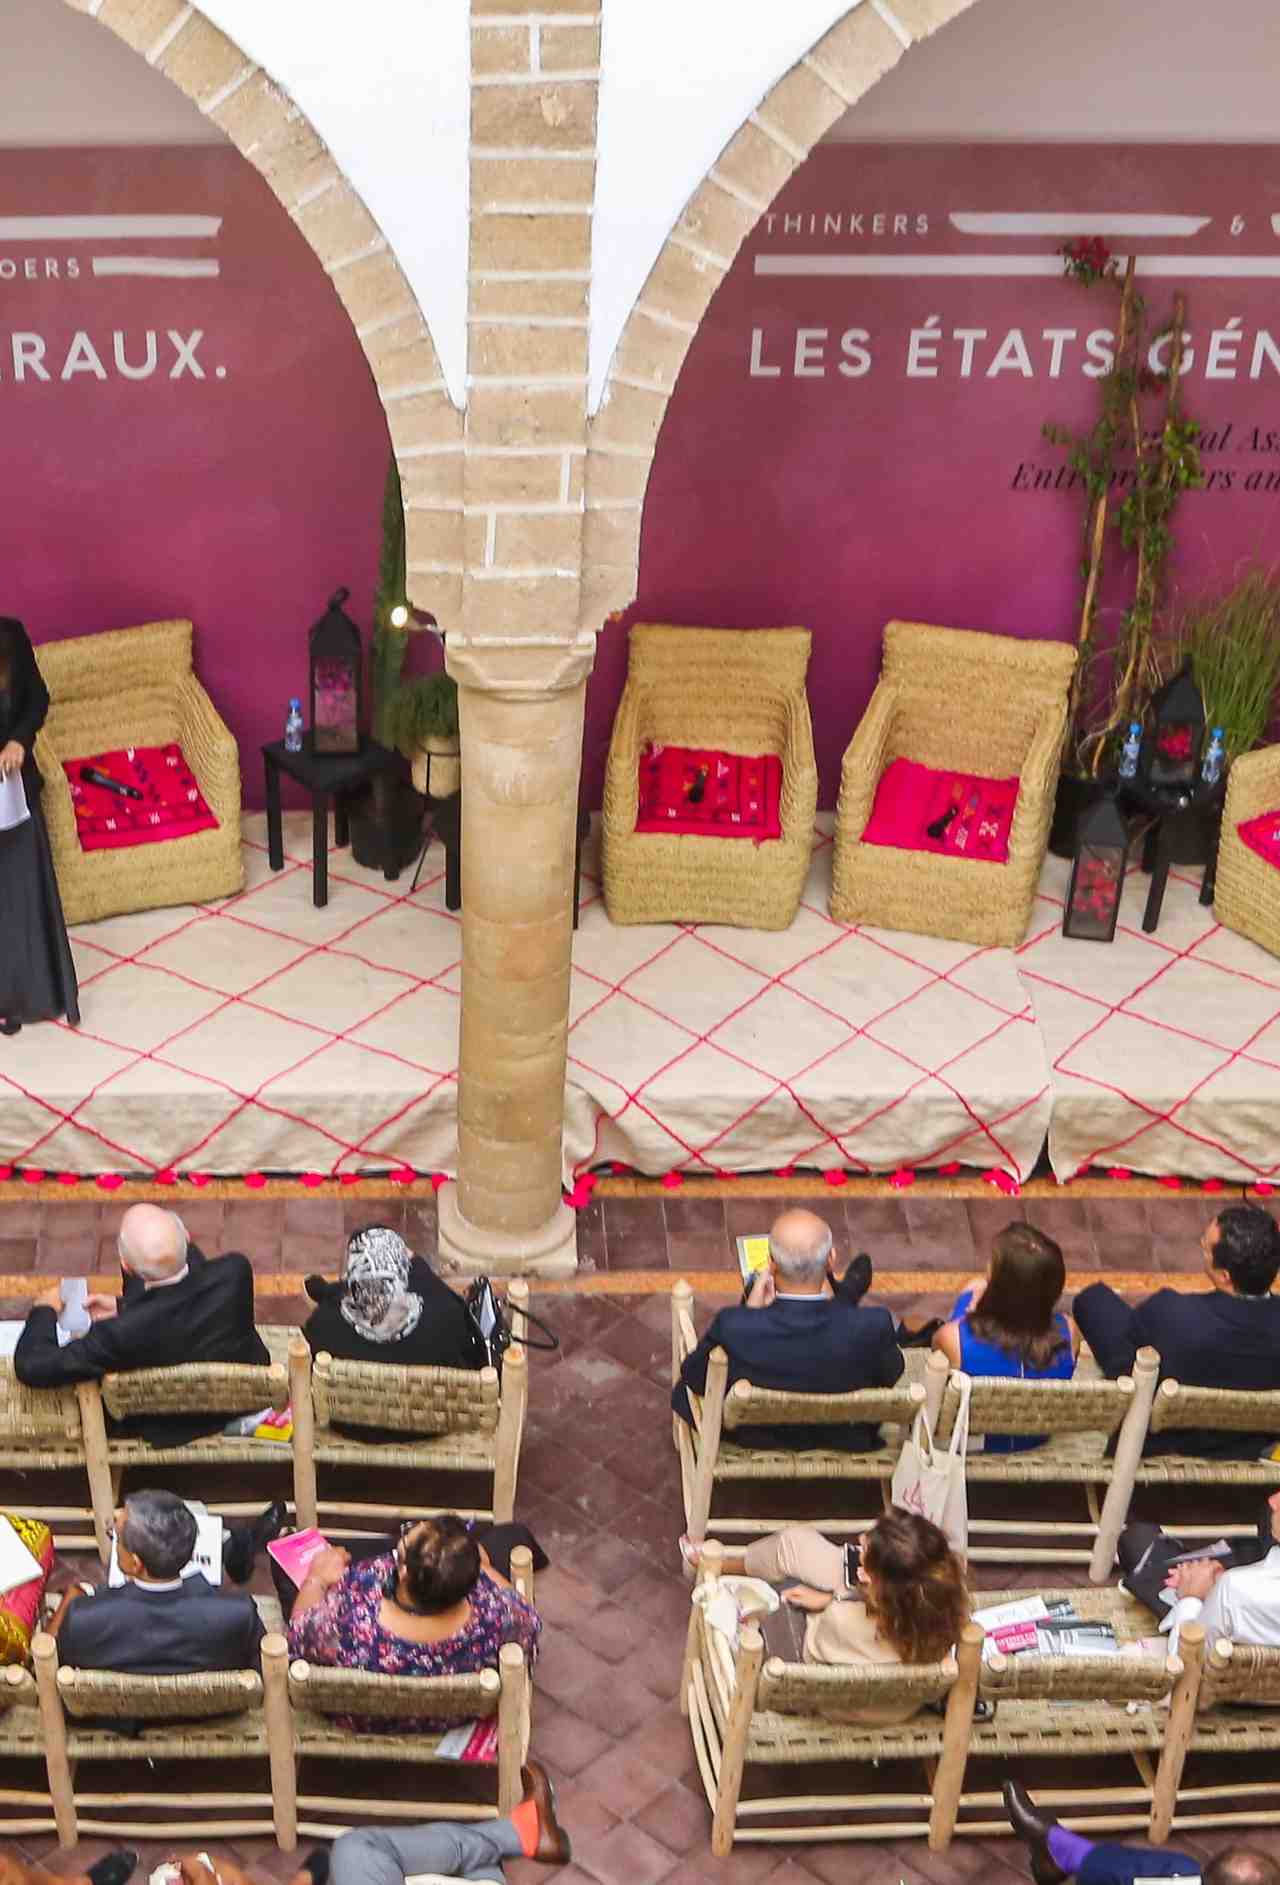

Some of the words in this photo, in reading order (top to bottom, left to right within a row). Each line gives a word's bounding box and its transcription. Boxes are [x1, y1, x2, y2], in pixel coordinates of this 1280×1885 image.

[765, 212, 930, 235] THINKERS
[750, 328, 871, 378] LES
[906, 314, 1115, 378] ÉTATS
